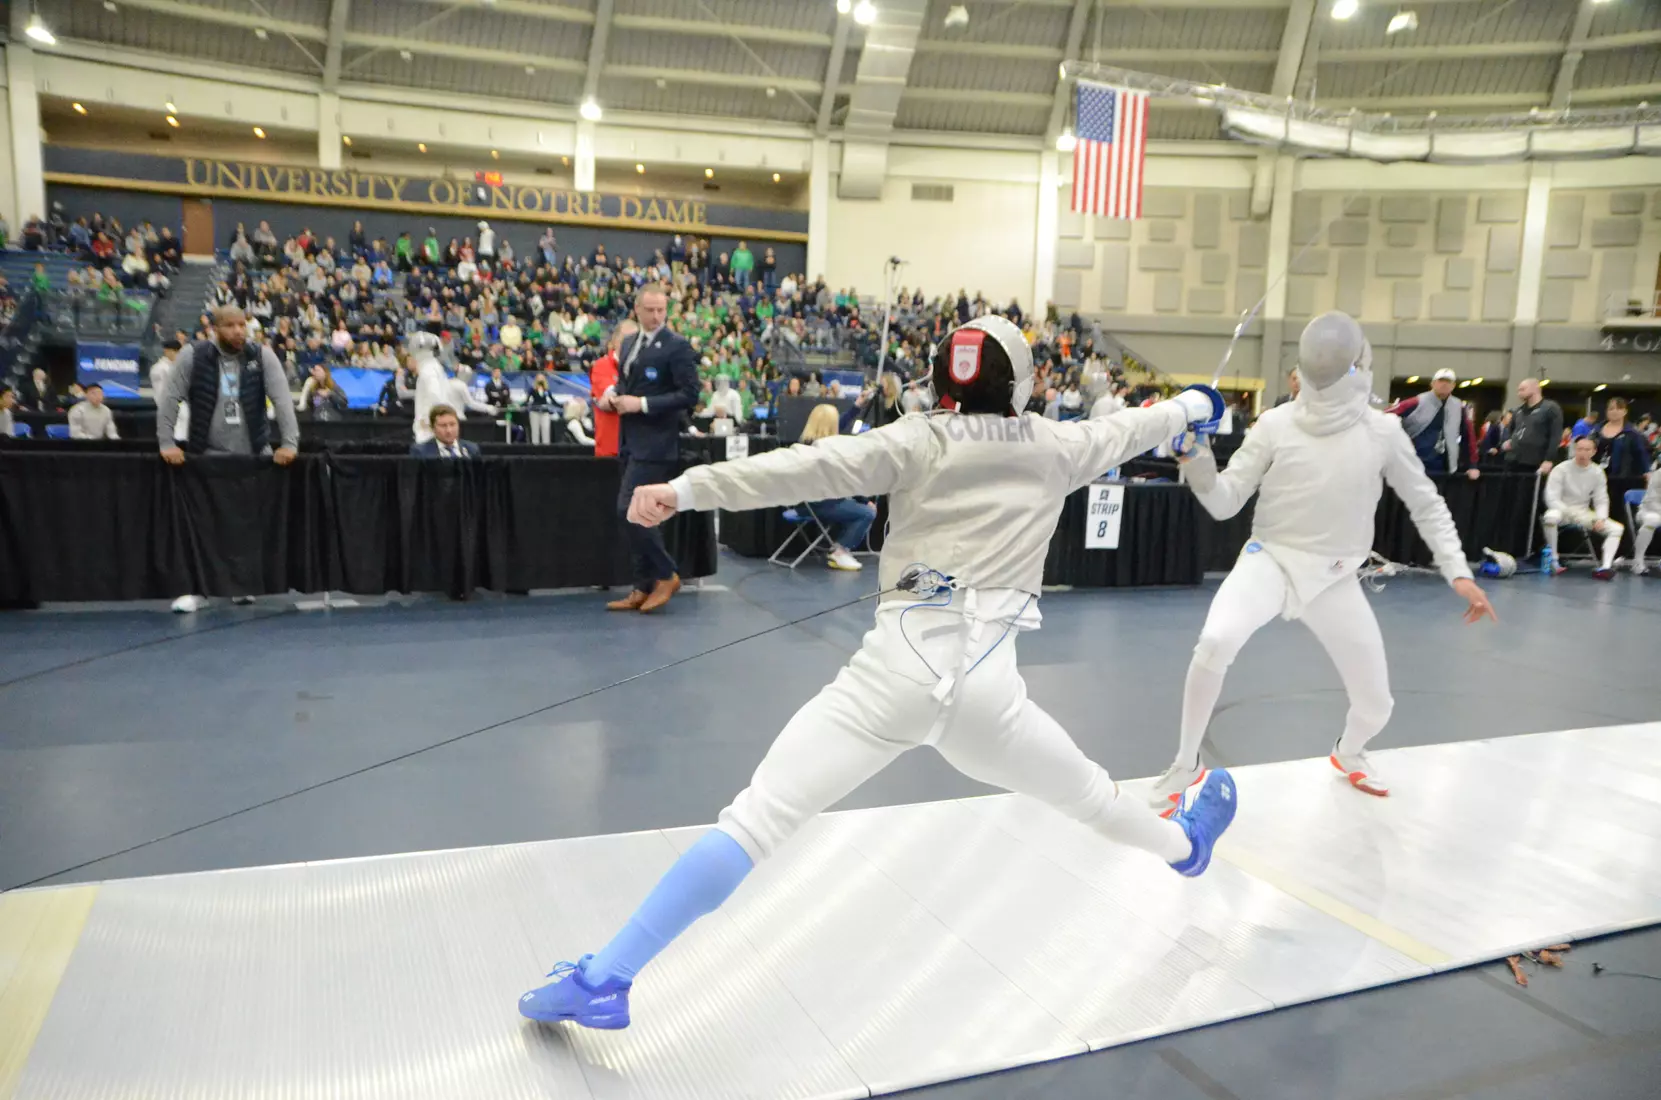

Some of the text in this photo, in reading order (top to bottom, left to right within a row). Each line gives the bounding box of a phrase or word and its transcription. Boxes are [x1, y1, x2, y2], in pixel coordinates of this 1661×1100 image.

[184, 157, 408, 202] UNIVERSITY
[428, 179, 472, 207] OF
[490, 184, 603, 216] NOTRE
[618, 196, 708, 226] DAME
[945, 413, 1036, 442] COHEN
[1090, 503, 1120, 517] STRIP
[1097, 520, 1108, 538] 8
